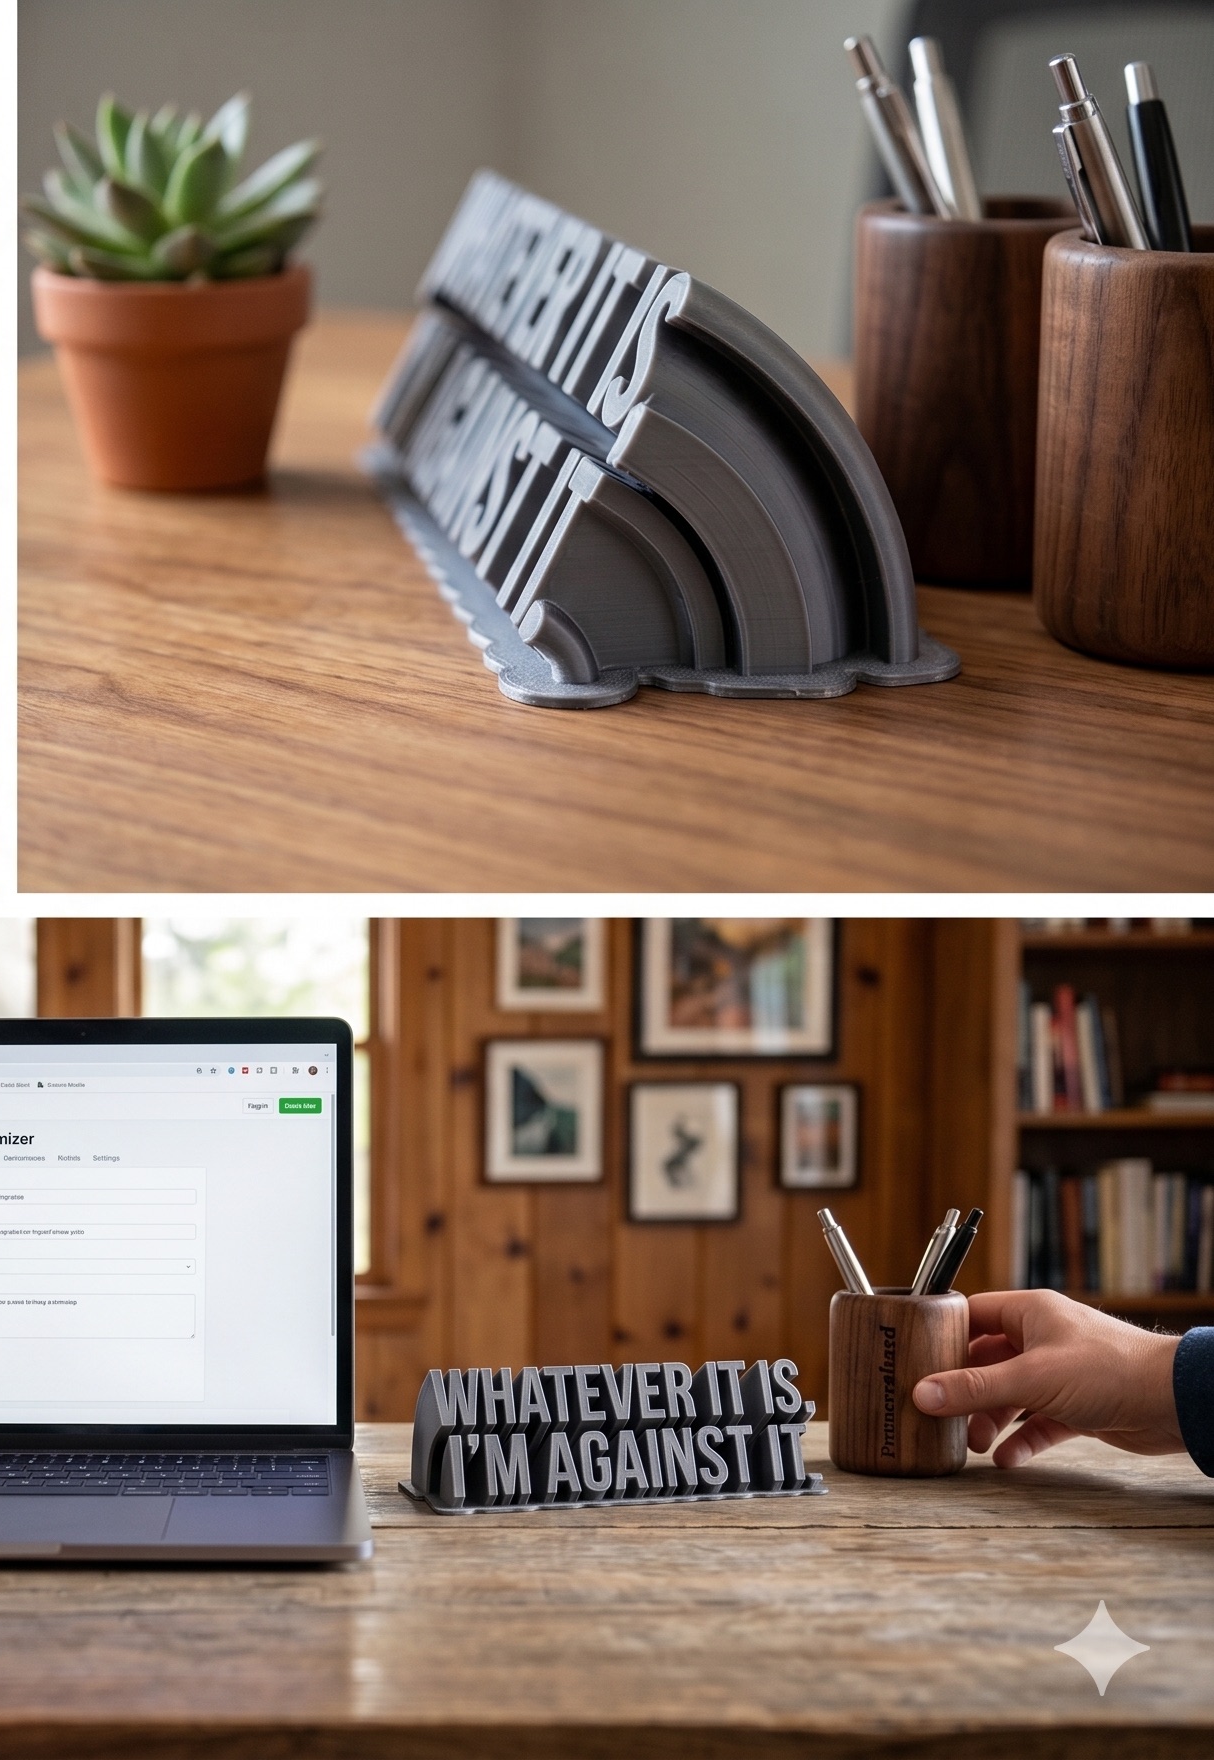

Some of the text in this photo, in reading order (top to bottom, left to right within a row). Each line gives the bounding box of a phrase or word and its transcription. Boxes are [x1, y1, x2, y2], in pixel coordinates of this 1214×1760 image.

[547, 242, 647, 395] IT
[92, 1154, 121, 1163] Settings
[428, 1358, 816, 1427] WHATEVER IT IS,
[449, 1432, 531, 1499] I'M
[546, 1425, 753, 1495] AGAINST
